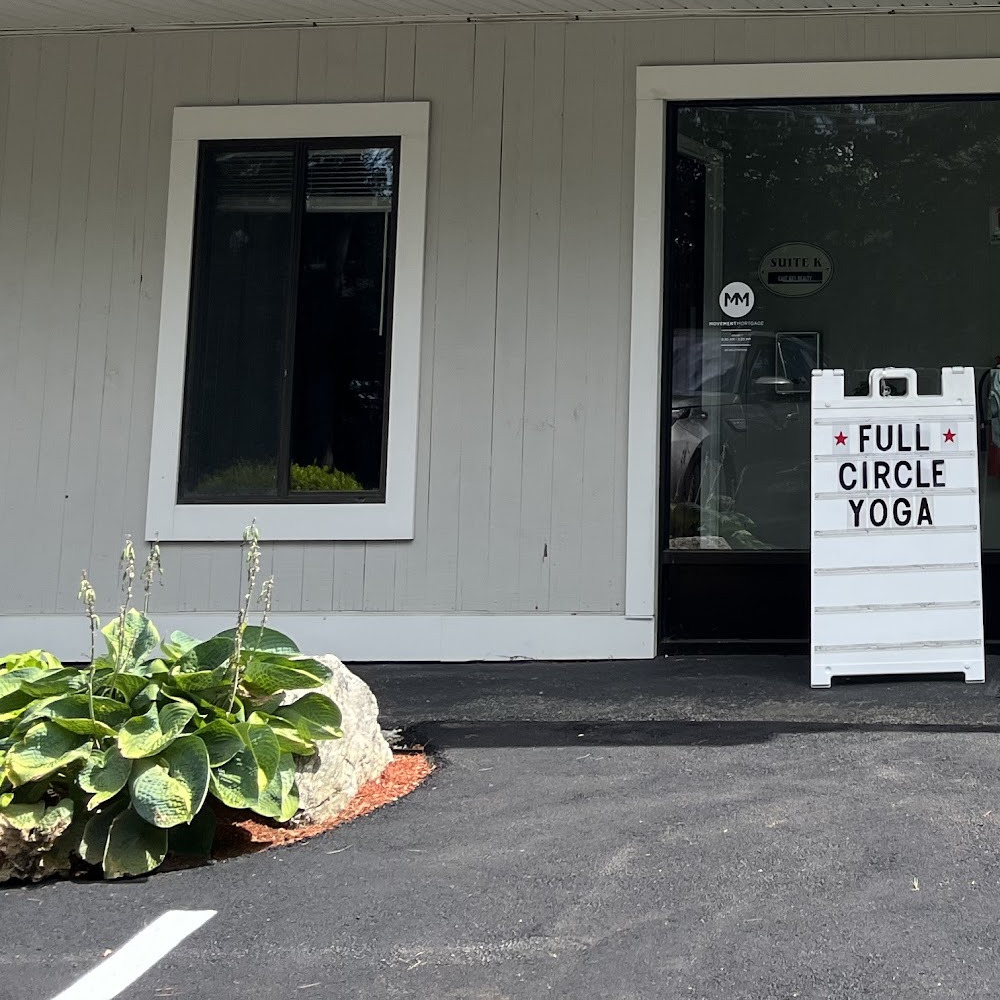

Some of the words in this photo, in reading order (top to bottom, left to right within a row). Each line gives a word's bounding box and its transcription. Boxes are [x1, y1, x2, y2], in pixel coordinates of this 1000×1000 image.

[770, 257, 810, 268] SUITE
[813, 257, 822, 268] K
[859, 423, 930, 453] FULL
[838, 459, 946, 491] CIRCLE
[848, 497, 933, 527] YOGA
